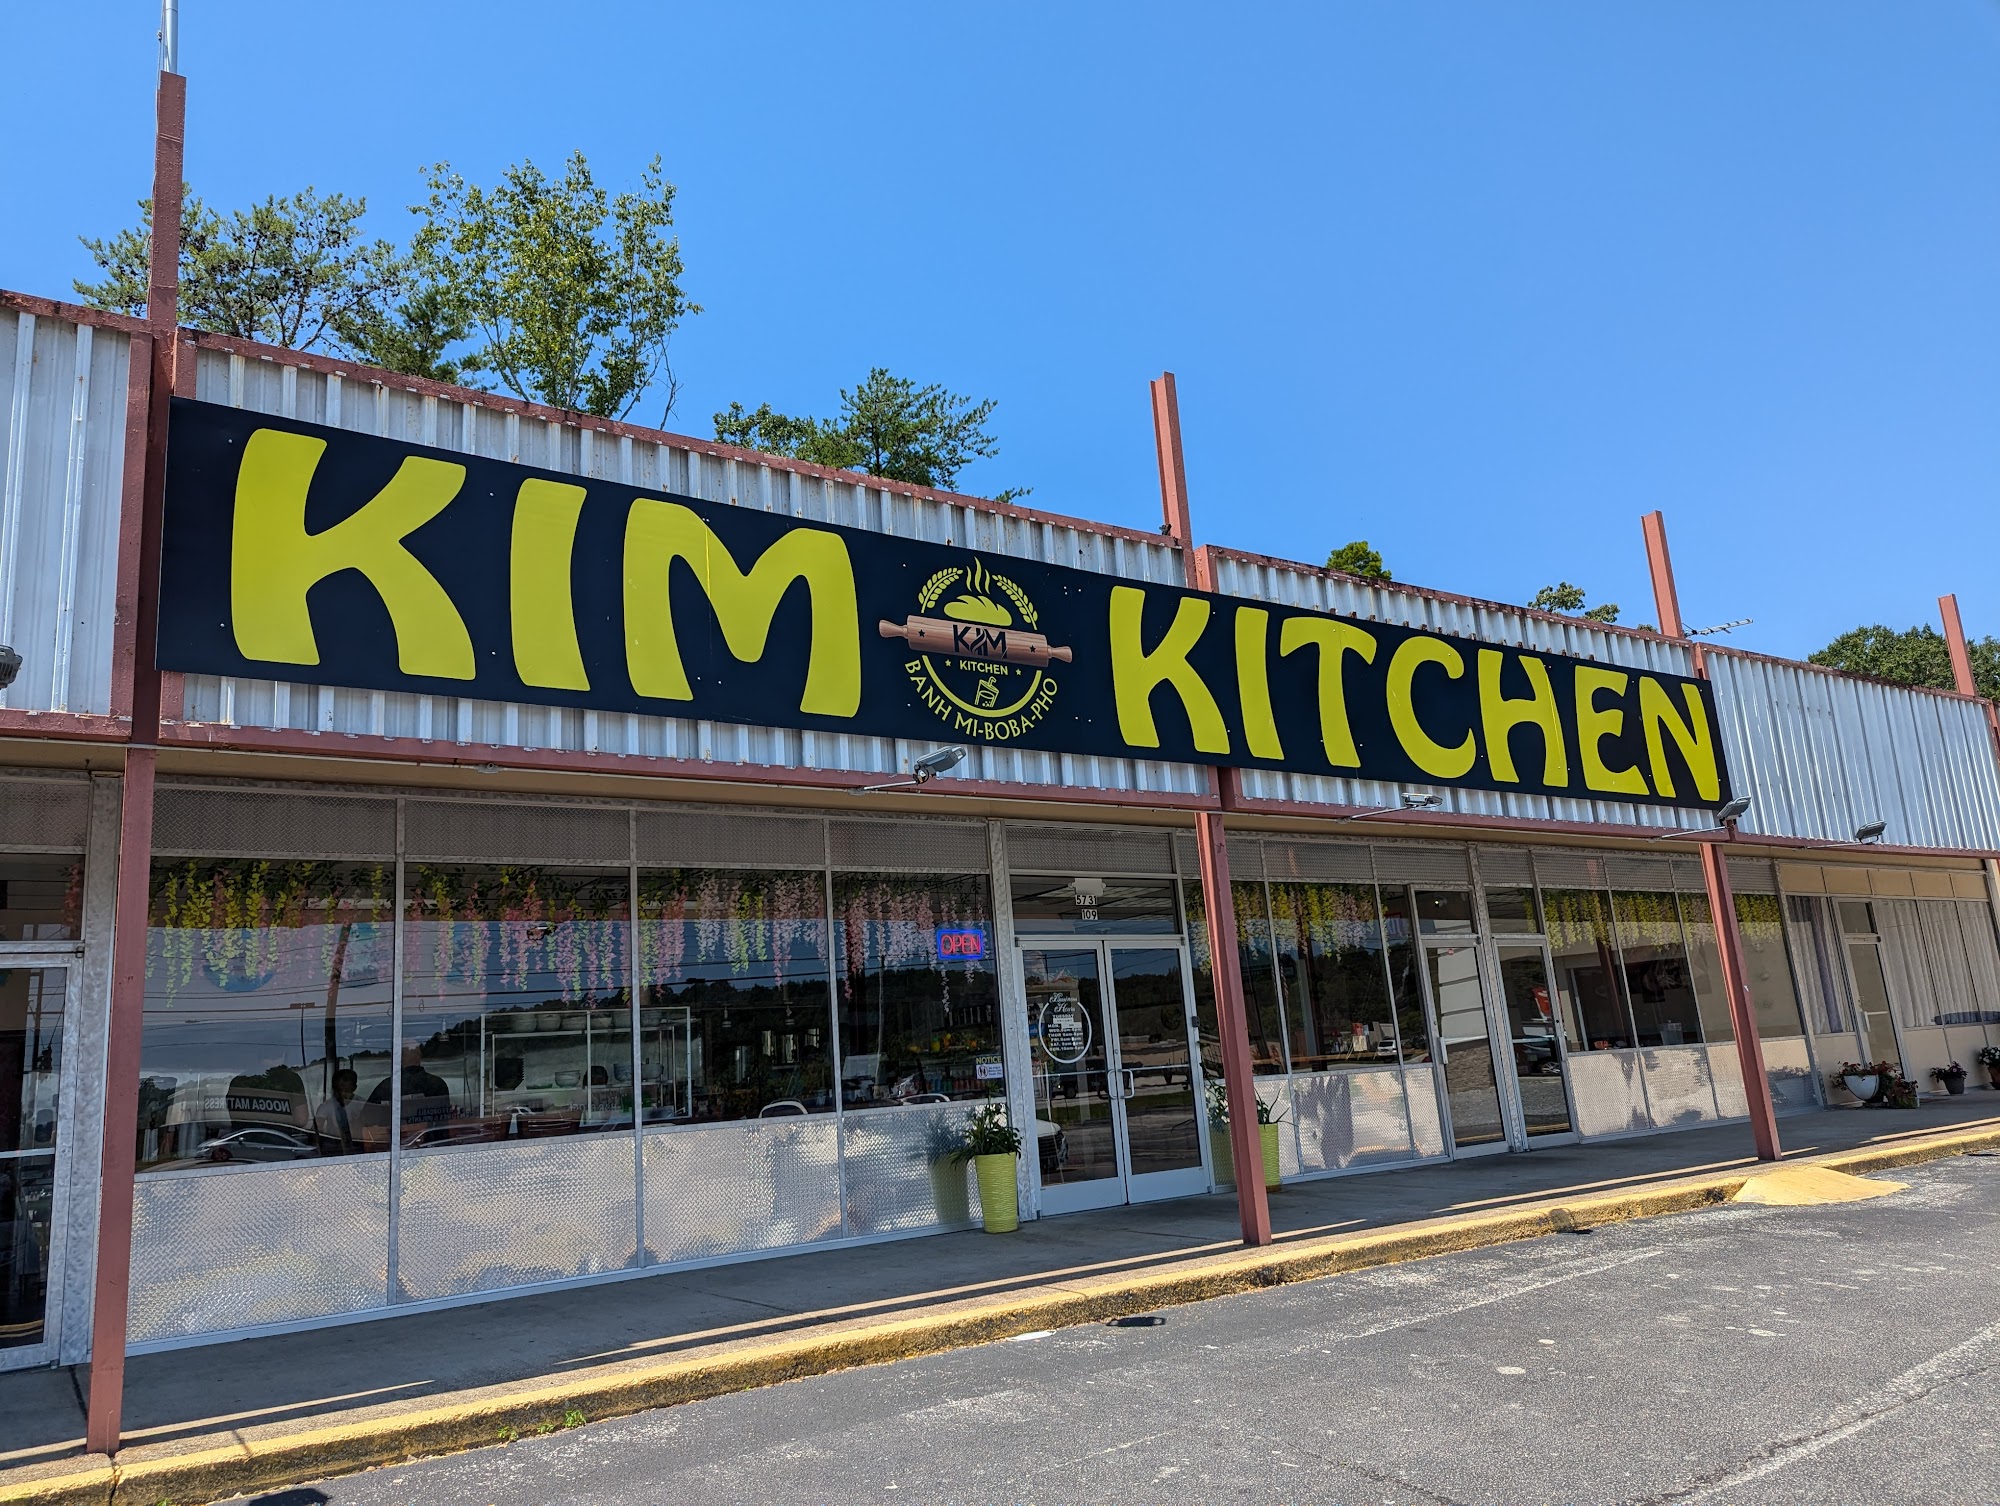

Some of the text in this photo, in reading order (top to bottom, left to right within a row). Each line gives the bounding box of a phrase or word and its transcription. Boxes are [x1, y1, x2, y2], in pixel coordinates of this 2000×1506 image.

[230, 427, 1720, 802] KIM KITCHEN
[952, 624, 1008, 659] KIM
[959, 660, 1009, 676] KITCHEN
[904, 659, 953, 722] BANH
[1076, 895, 1097, 905] 5731
[1082, 909, 1097, 919] 109
[941, 933, 980, 955] OPEN
[976, 1055, 1002, 1065] NOTICE
